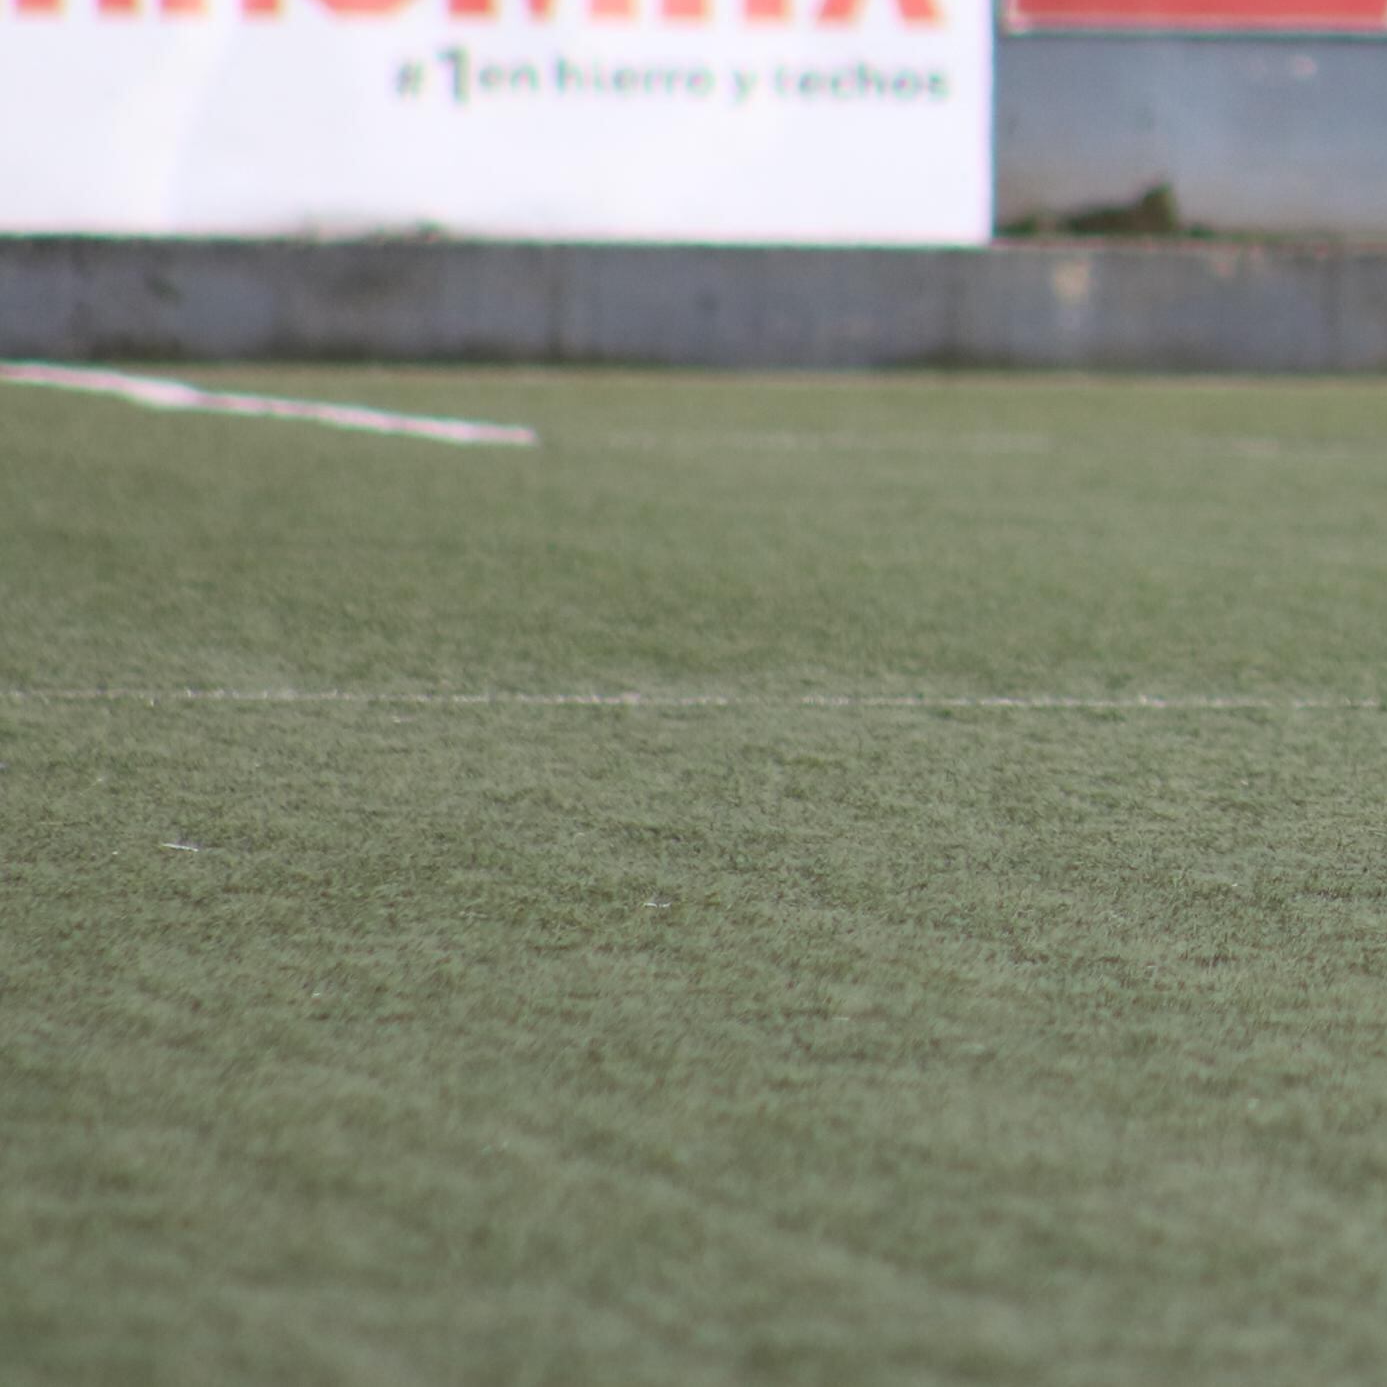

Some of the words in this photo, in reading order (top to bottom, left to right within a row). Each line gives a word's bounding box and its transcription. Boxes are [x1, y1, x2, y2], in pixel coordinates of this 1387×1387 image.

[555, 56, 717, 98] hierro
[731, 69, 759, 105] y
[773, 59, 950, 102] techos
